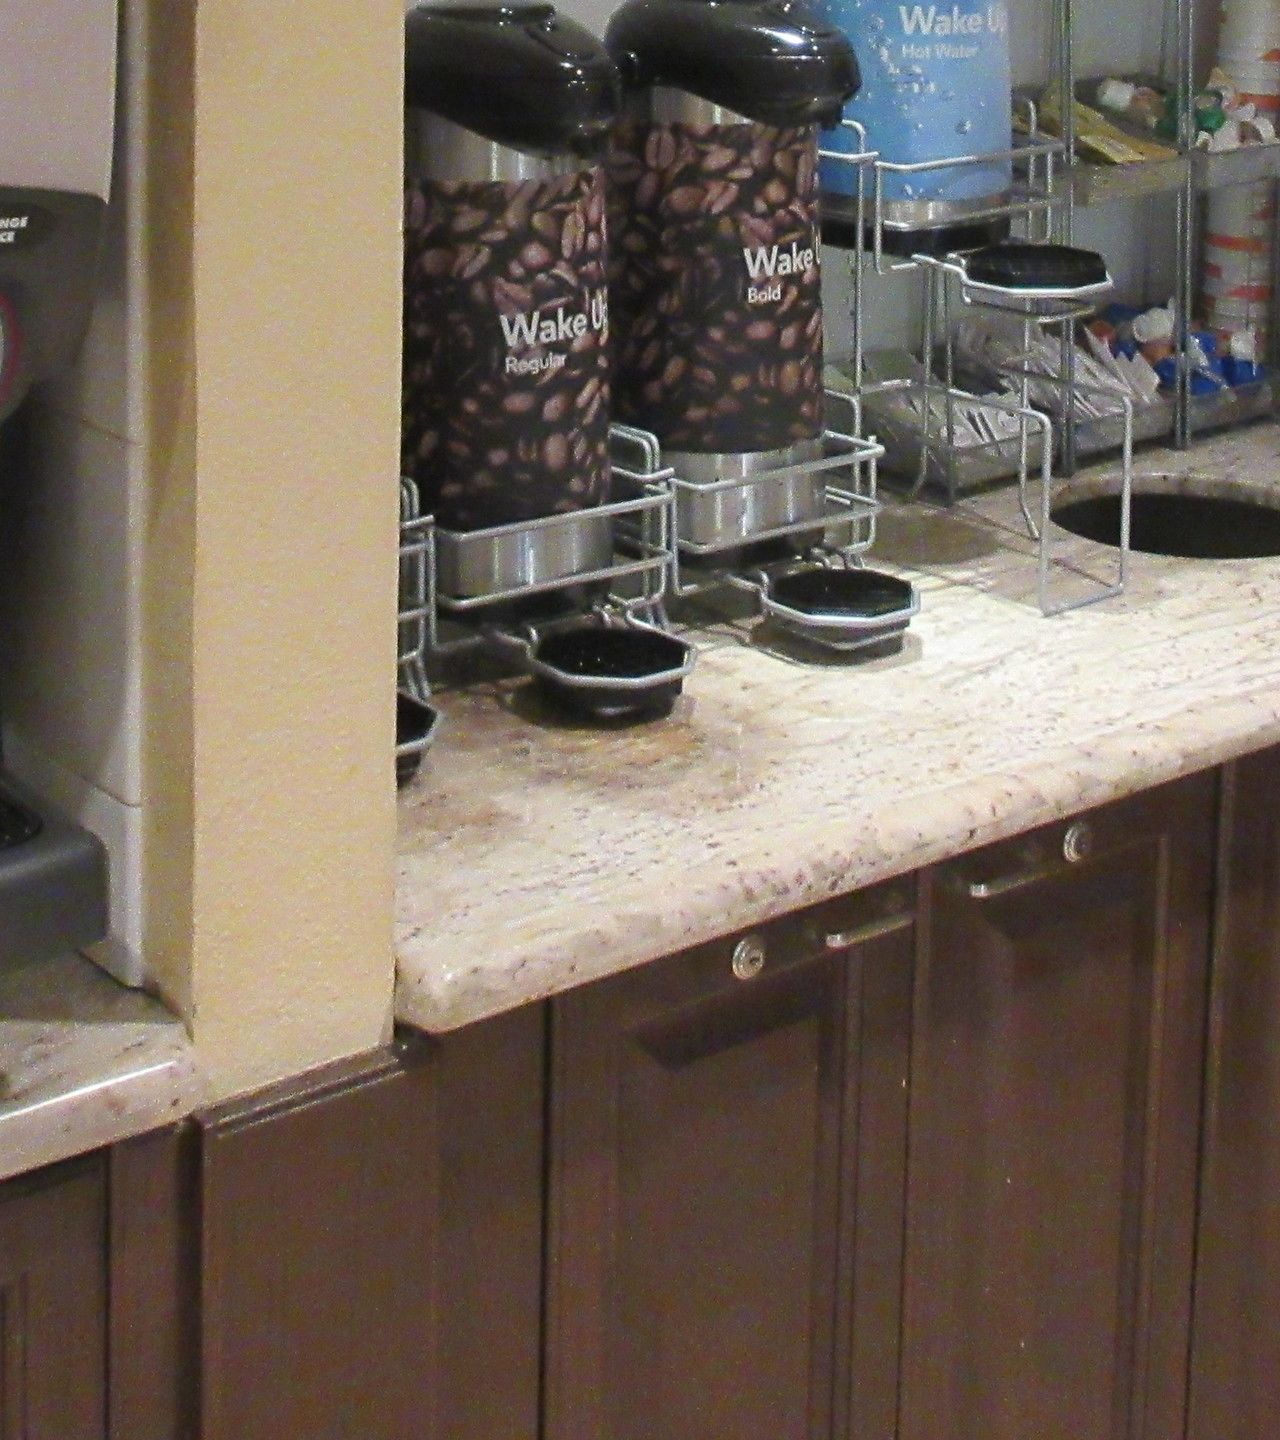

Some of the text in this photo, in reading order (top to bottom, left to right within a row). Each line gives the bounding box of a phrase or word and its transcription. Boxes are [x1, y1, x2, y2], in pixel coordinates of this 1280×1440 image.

[899, 5, 982, 35] Wake
[744, 242, 813, 278] Wake
[747, 282, 781, 303] Bold
[500, 309, 588, 347] Wake
[505, 352, 567, 375] Regular
